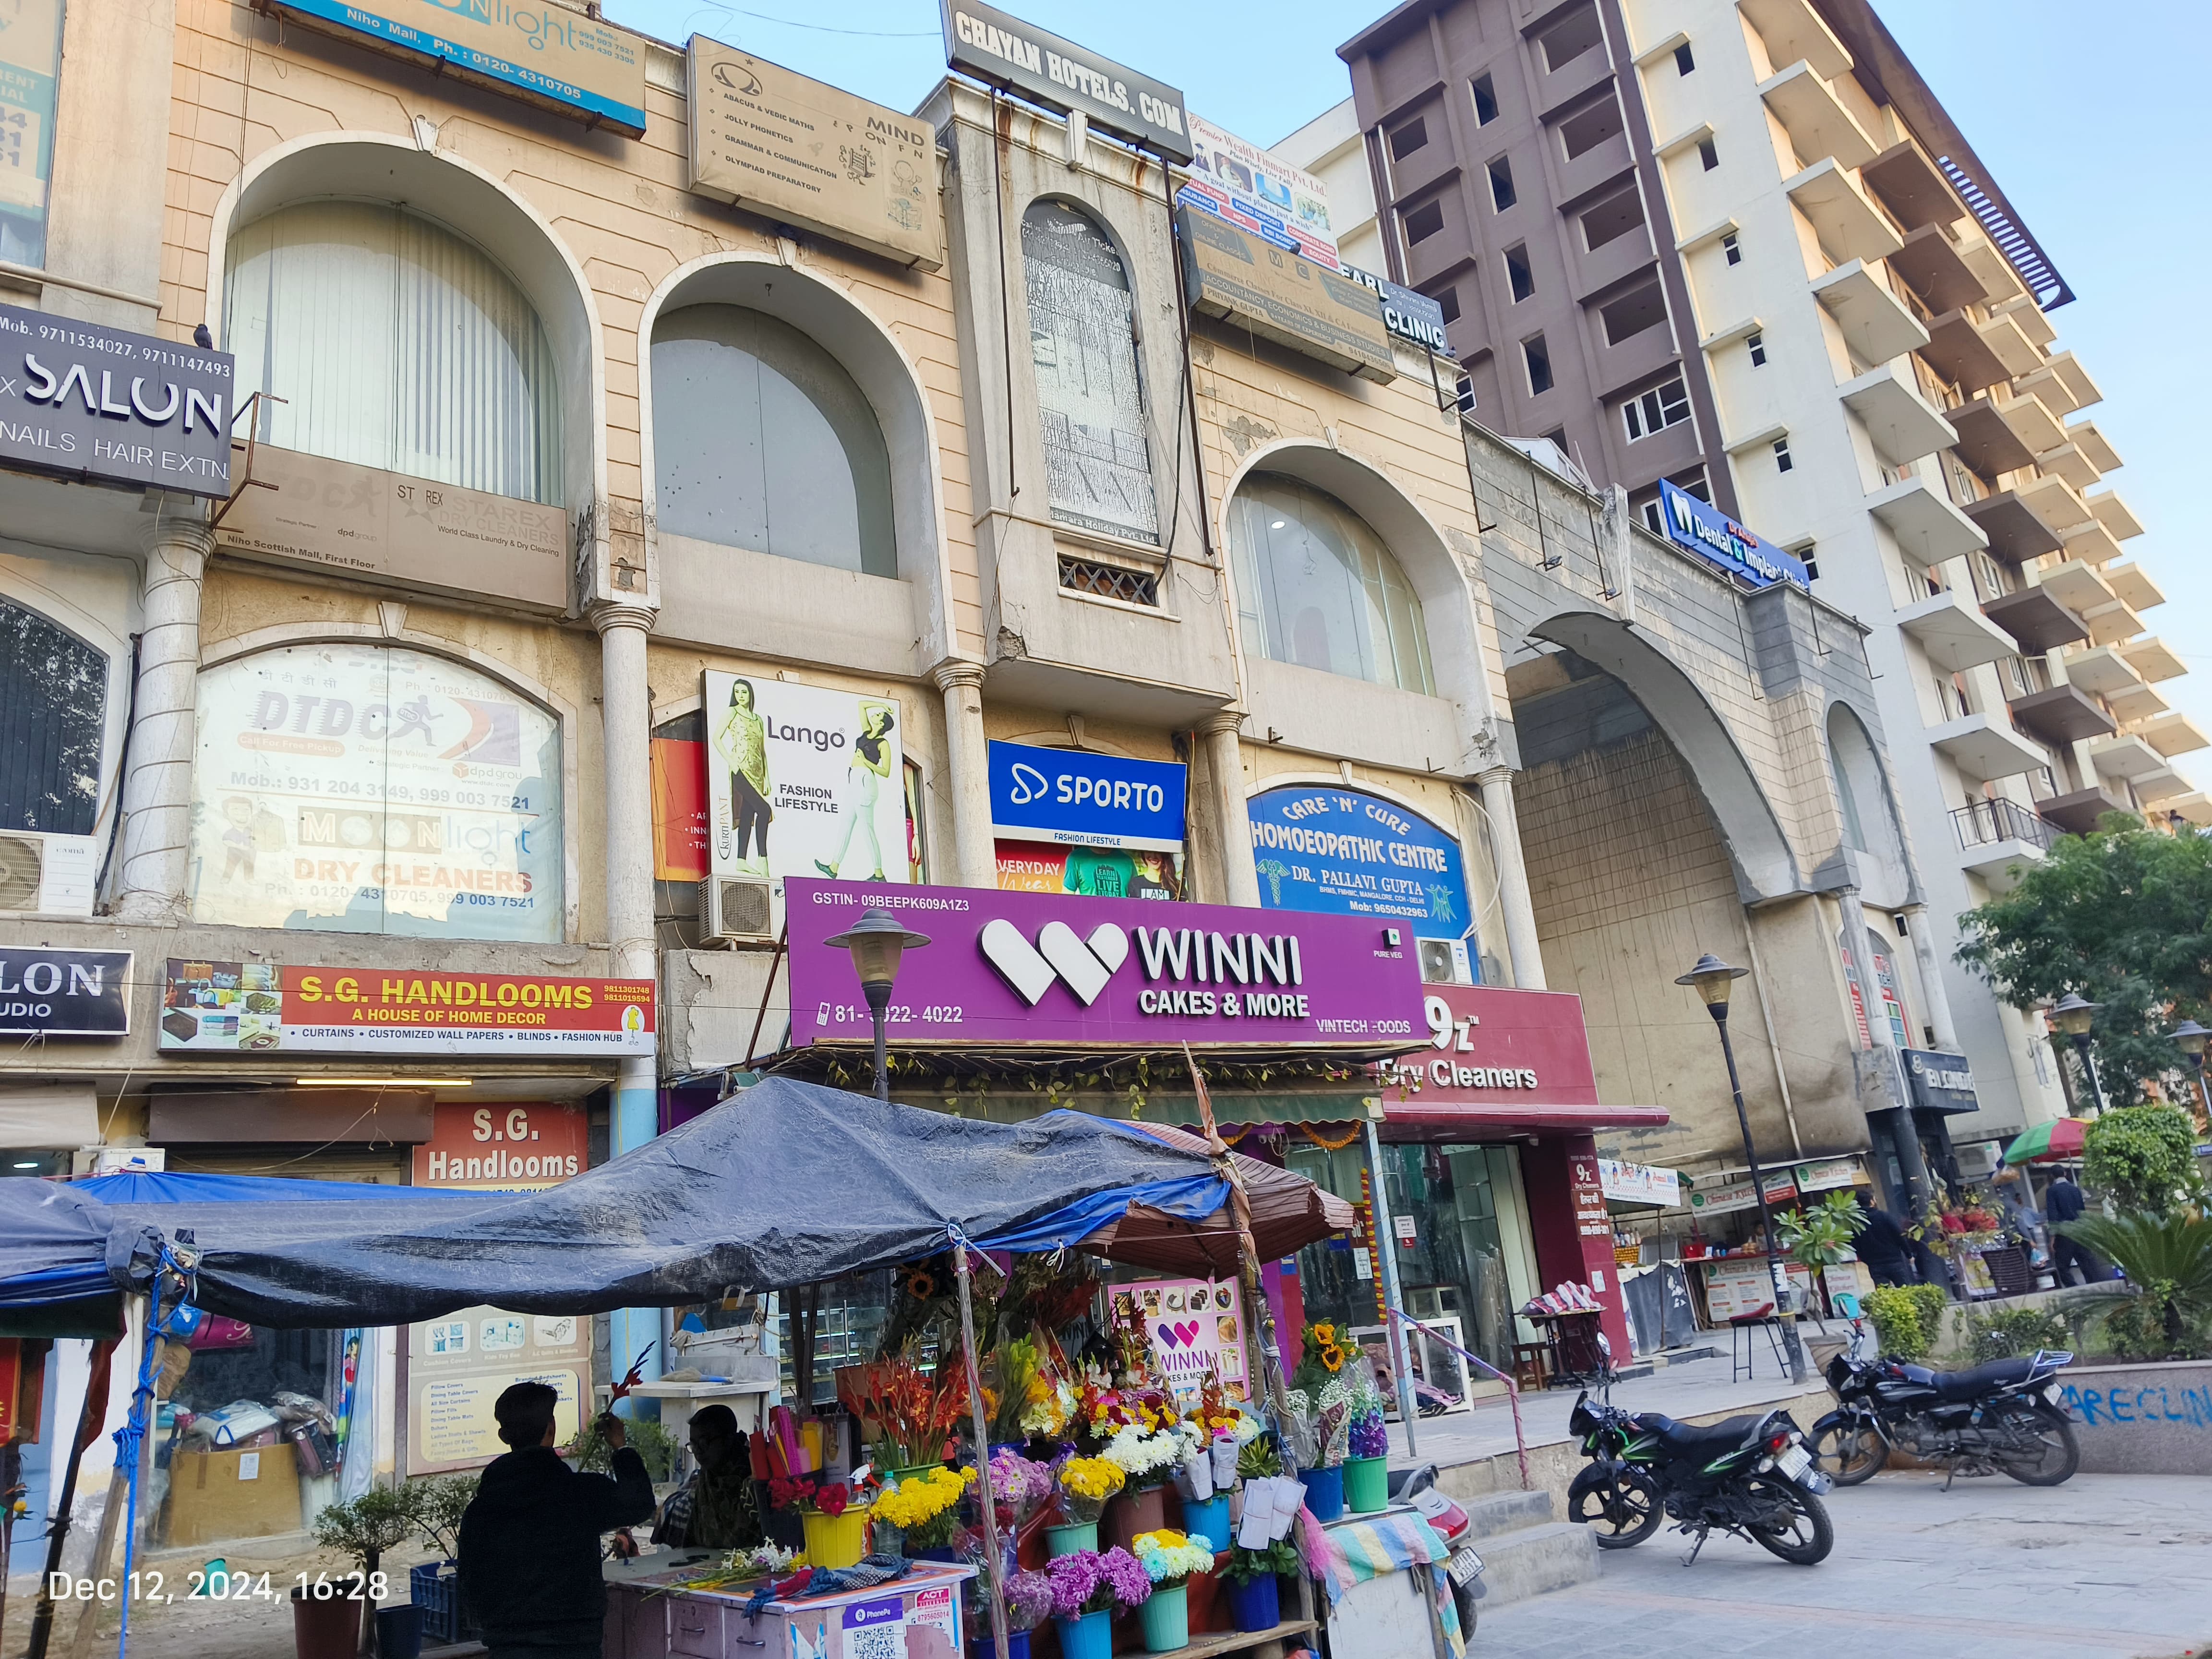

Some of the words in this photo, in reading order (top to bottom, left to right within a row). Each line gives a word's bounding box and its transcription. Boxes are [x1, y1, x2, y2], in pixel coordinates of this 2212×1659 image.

[347, 8, 380, 28] Niho
[389, 23, 421, 44] Mall,
[433, 39, 457, 56] Ph.
[472, 53, 515, 74] 0120-
[518, 70, 582, 99] 4310705
[955, 11, 1043, 75] CHAYAN
[1046, 50, 1136, 116] HOTELS.
[1139, 91, 1184, 136] COM
[723, 92, 755, 109] ABACUS
[765, 107, 787, 121] VEDIC
[789, 115, 815, 131] MATHS
[724, 113, 748, 128] JOLLY
[750, 123, 793, 144] PHONETICS
[866, 117, 925, 146] MIND
[725, 134, 764, 154] GRAMMAR
[774, 152, 837, 179] COMMUNICATION
[1224, 135, 1254, 160] Wealth
[1256, 152, 1291, 179] Finmart
[1292, 170, 1308, 188] Pvt.
[1310, 180, 1327, 197] Ltd.
[1230, 150, 1243, 161] Plan
[1265, 168, 1277, 179] Live
[1279, 175, 1293, 188] Fully
[726, 155, 765, 174] OLYMPIAD
[767, 170, 821, 193] PREPARATORY
[1210, 177, 1225, 188] goal
[1227, 184, 1251, 202] without
[1254, 197, 1268, 209] plan
[1276, 207, 1288, 220] just
[1288, 227, 1320, 249] CORPORATE
[1207, 288, 1238, 307] PRIYANK
[1240, 301, 1264, 317] GUPTA
[1267, 301, 1313, 325] ECONOMICS
[1320, 323, 1356, 344] BUSINESS
[1384, 307, 1445, 348] CLINIC
[0, 316, 33, 336] Mob.
[39, 325, 138, 360] 9711534027,
[143, 348, 231, 377] 9711147493
[24, 353, 223, 434] SALON
[0, 420, 76, 452] NAILS
[95, 438, 155, 467] HAIR
[161, 450, 230, 481] EXTN.
[439, 510, 470, 527] DRY
[475, 517, 560, 547] CLEANERS
[452, 495, 552, 530] STAREX
[437, 524, 458, 536] World
[459, 529, 480, 540] Class
[481, 534, 508, 548] Laundry
[517, 541, 529, 552] Dry
[530, 544, 560, 558] Cleaning
[1086, 519, 1120, 537] Holiday
[1122, 528, 1139, 541] Pvt.
[1140, 533, 1158, 545] Ltd.
[1694, 514, 1734, 557] Dental
[227, 534, 251, 547] Niho
[253, 538, 296, 555] Scottish
[298, 547, 323, 561] Mall,
[325, 552, 349, 565] First
[350, 557, 376, 570] Floor
[248, 690, 391, 741] DTDC
[240, 735, 260, 745] Call
[263, 737, 280, 748] For
[282, 739, 304, 750] Free
[307, 741, 341, 755] Pickup
[767, 715, 845, 752] Lango
[288, 777, 320, 792] 931
[327, 780, 361, 795] 204
[419, 787, 450, 803] 999
[456, 790, 485, 806] 003
[491, 794, 529, 810] 7521
[774, 797, 839, 814] LIFESTYLE
[780, 783, 833, 800] FASHION
[1057, 774, 1164, 813] SPORTO
[1282, 796, 1329, 821] CARE
[1365, 803, 1411, 836] CURE
[1054, 833, 1085, 843] FASHION
[1086, 835, 1121, 846] LIFESTYLE
[1250, 820, 1386, 864] HOMOEOPATHIC
[1388, 842, 1448, 874] CENTRE
[294, 858, 361, 882] DRY
[371, 863, 533, 893] CLEANERS
[997, 859, 1060, 876] VERYDAY
[1291, 865, 1316, 883] DR.
[1321, 869, 1376, 890] PALLAVI
[1381, 878, 1424, 897] GUPTA
[437, 891, 464, 906] 999
[469, 893, 496, 907] 003
[500, 895, 534, 909] 7521
[812, 891, 859, 905] GSTIN-
[861, 894, 970, 911] 09BEEPK609A1Z3
[1097, 880, 1120, 891] LIVE
[1359, 890, 1394, 901] MANGALORE,
[1409, 896, 1425, 904] DELHI
[1350, 900, 1372, 913] Mob:
[1374, 903, 1428, 918] 9650432963
[1136, 925, 1303, 986] WINNI
[1374, 950, 1389, 959] PURE
[1390, 951, 1403, 959] VEG
[0, 962, 106, 997] LON
[298, 975, 369, 1003] S.G.
[381, 978, 594, 1010] HANDLOOMS
[603, 985, 650, 994] 9811301748
[603, 993, 651, 1003] 9811019594
[835, 1005, 864, 1022] 81-
[868, 1005, 918, 1023] 22-
[922, 1005, 963, 1023] 4022
[1140, 990, 1217, 1015] CAKES
[1247, 993, 1311, 1018] MORE
[352, 1008, 364, 1021] A
[368, 1009, 421, 1023] HOUSE
[425, 1010, 445, 1023] OF
[448, 1011, 493, 1024] HOME
[496, 1012, 546, 1026] DECOR
[1315, 1018, 1369, 1034] VINTECH
[302, 1028, 354, 1038] CURTAINS
[368, 1029, 434, 1041] CUSTOMIZED
[437, 1031, 464, 1041] WALL
[466, 1031, 505, 1042] PAPERS
[517, 1032, 552, 1042] BLINDS
[561, 1033, 601, 1042] FASHION
[603, 1033, 623, 1043] HUB
[1429, 1059, 1539, 1089] Cleaners
[472, 1108, 540, 1142] S.G.
[428, 1150, 579, 1180] Handlooms
[922, 1589, 944, 1600] ACT
